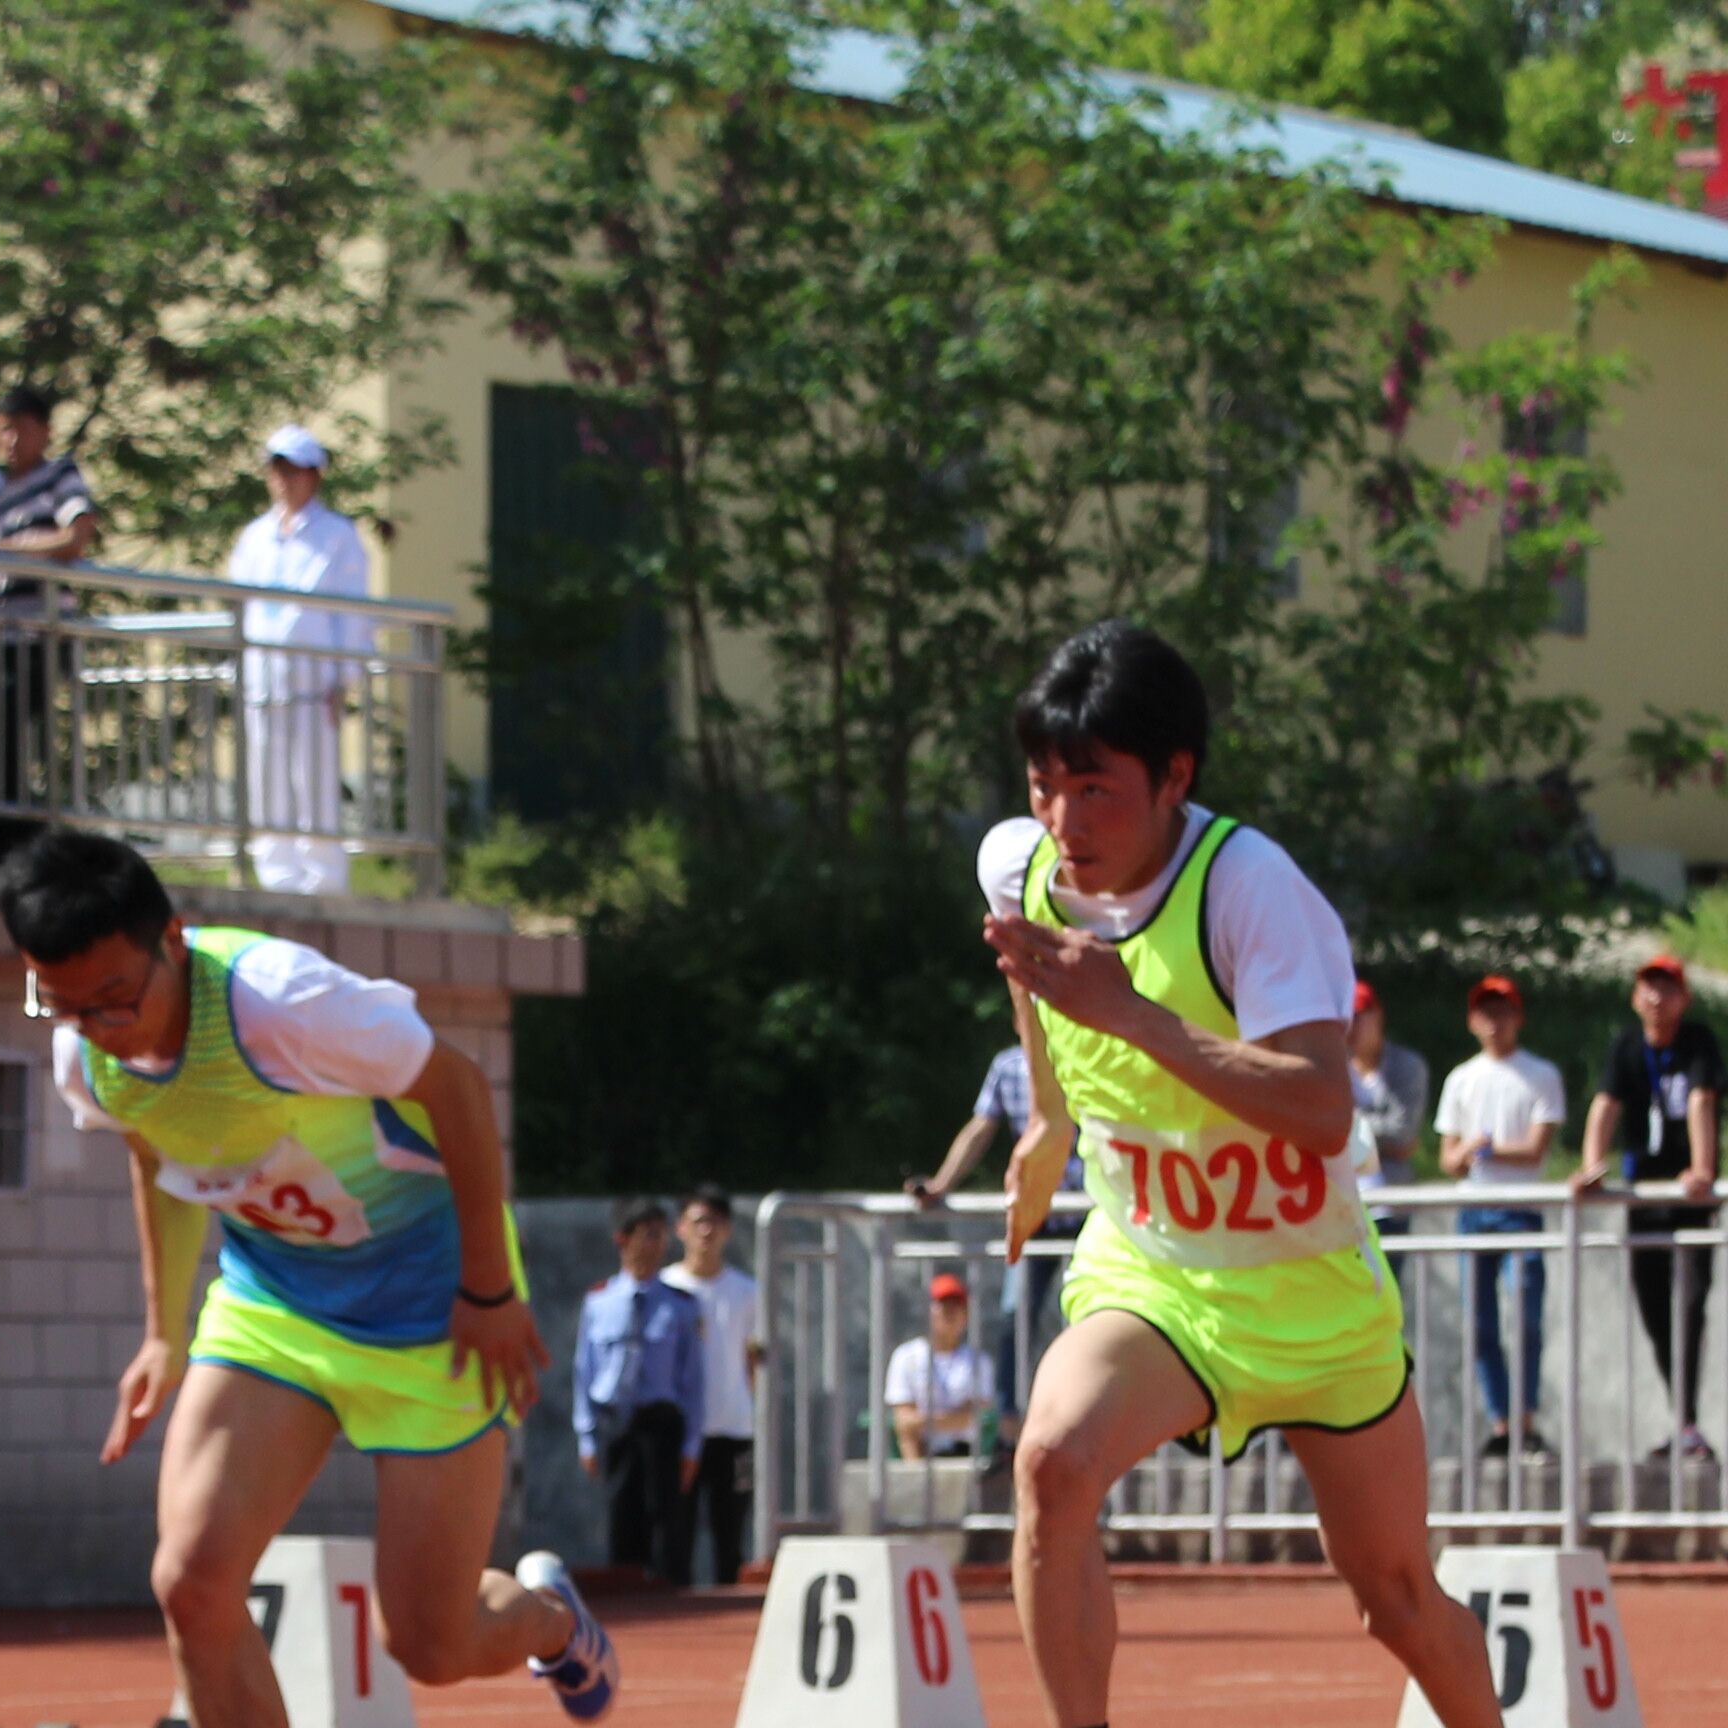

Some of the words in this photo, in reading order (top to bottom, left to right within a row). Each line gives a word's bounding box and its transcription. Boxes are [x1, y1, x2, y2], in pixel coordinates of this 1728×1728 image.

[800, 1572, 858, 1689] 6
[906, 1567, 951, 1689] 6
[1470, 1591, 1533, 1709] 5
[1574, 1588, 1617, 1711] 5
